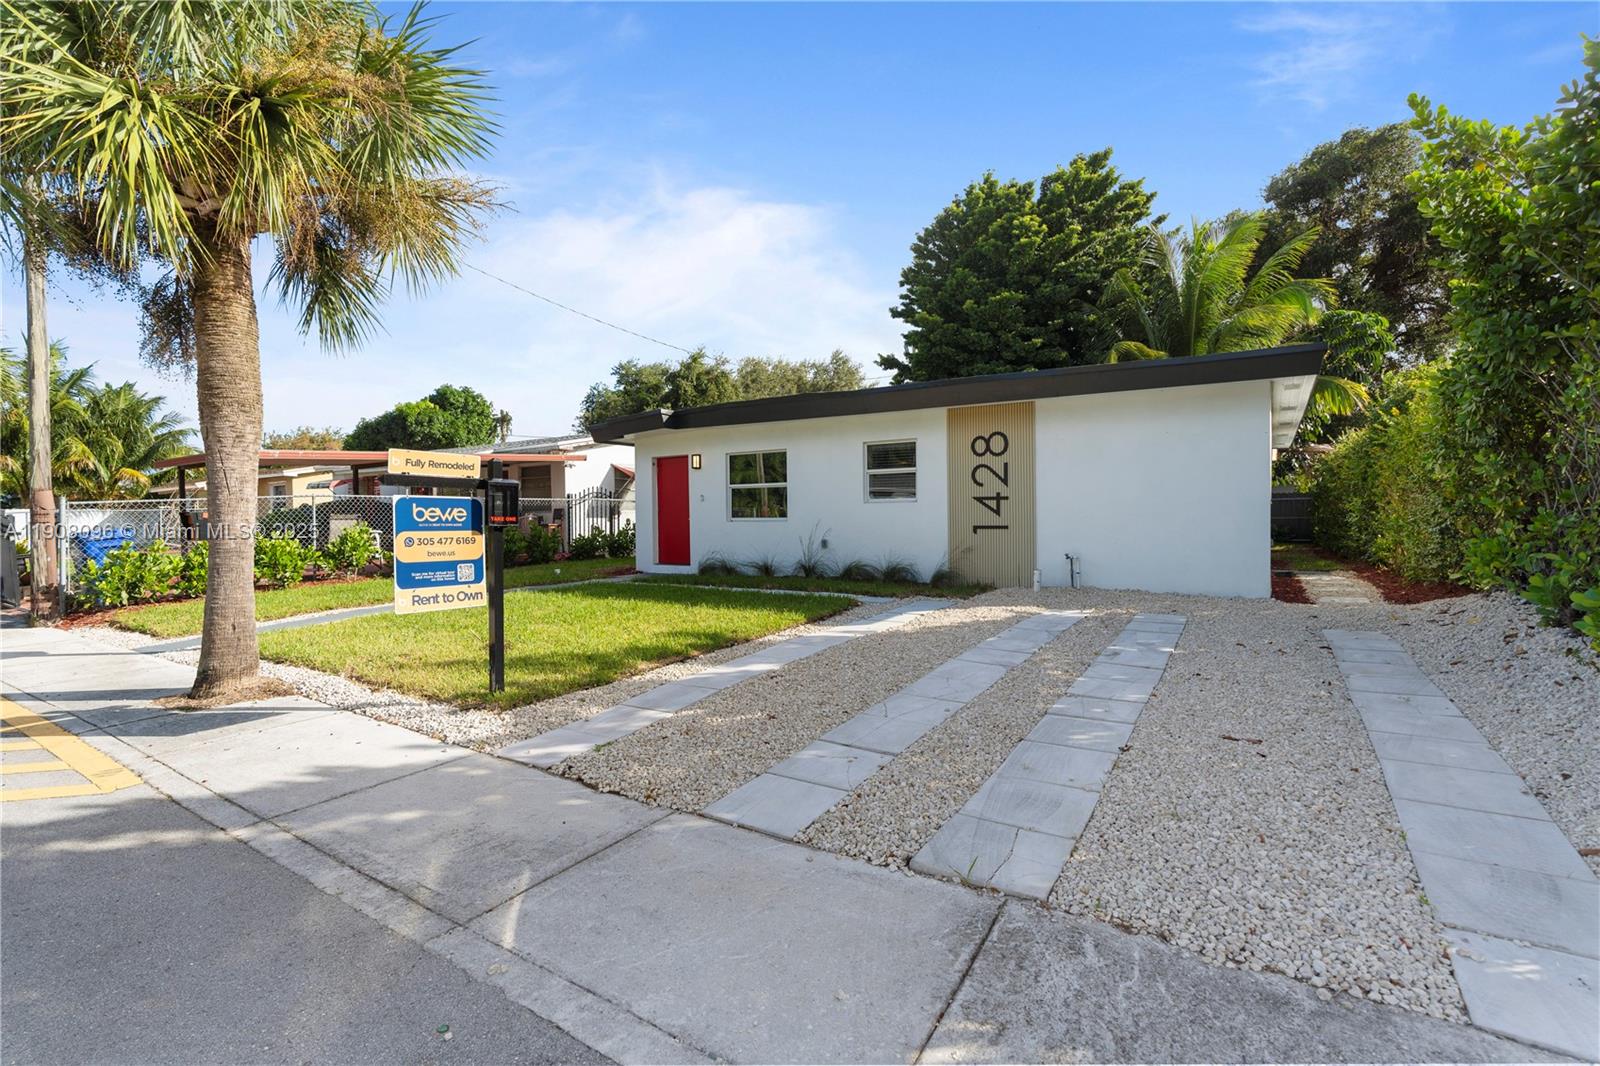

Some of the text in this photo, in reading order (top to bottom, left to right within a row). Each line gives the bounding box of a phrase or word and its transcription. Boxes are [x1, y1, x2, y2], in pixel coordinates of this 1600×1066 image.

[405, 458, 475, 471] Fully Remodeled
[970, 431, 1009, 535] 1428
[412, 503, 467, 522] bewe
[416, 536, 476, 546] 305 477 6169
[411, 590, 484, 606] Rent to Own
